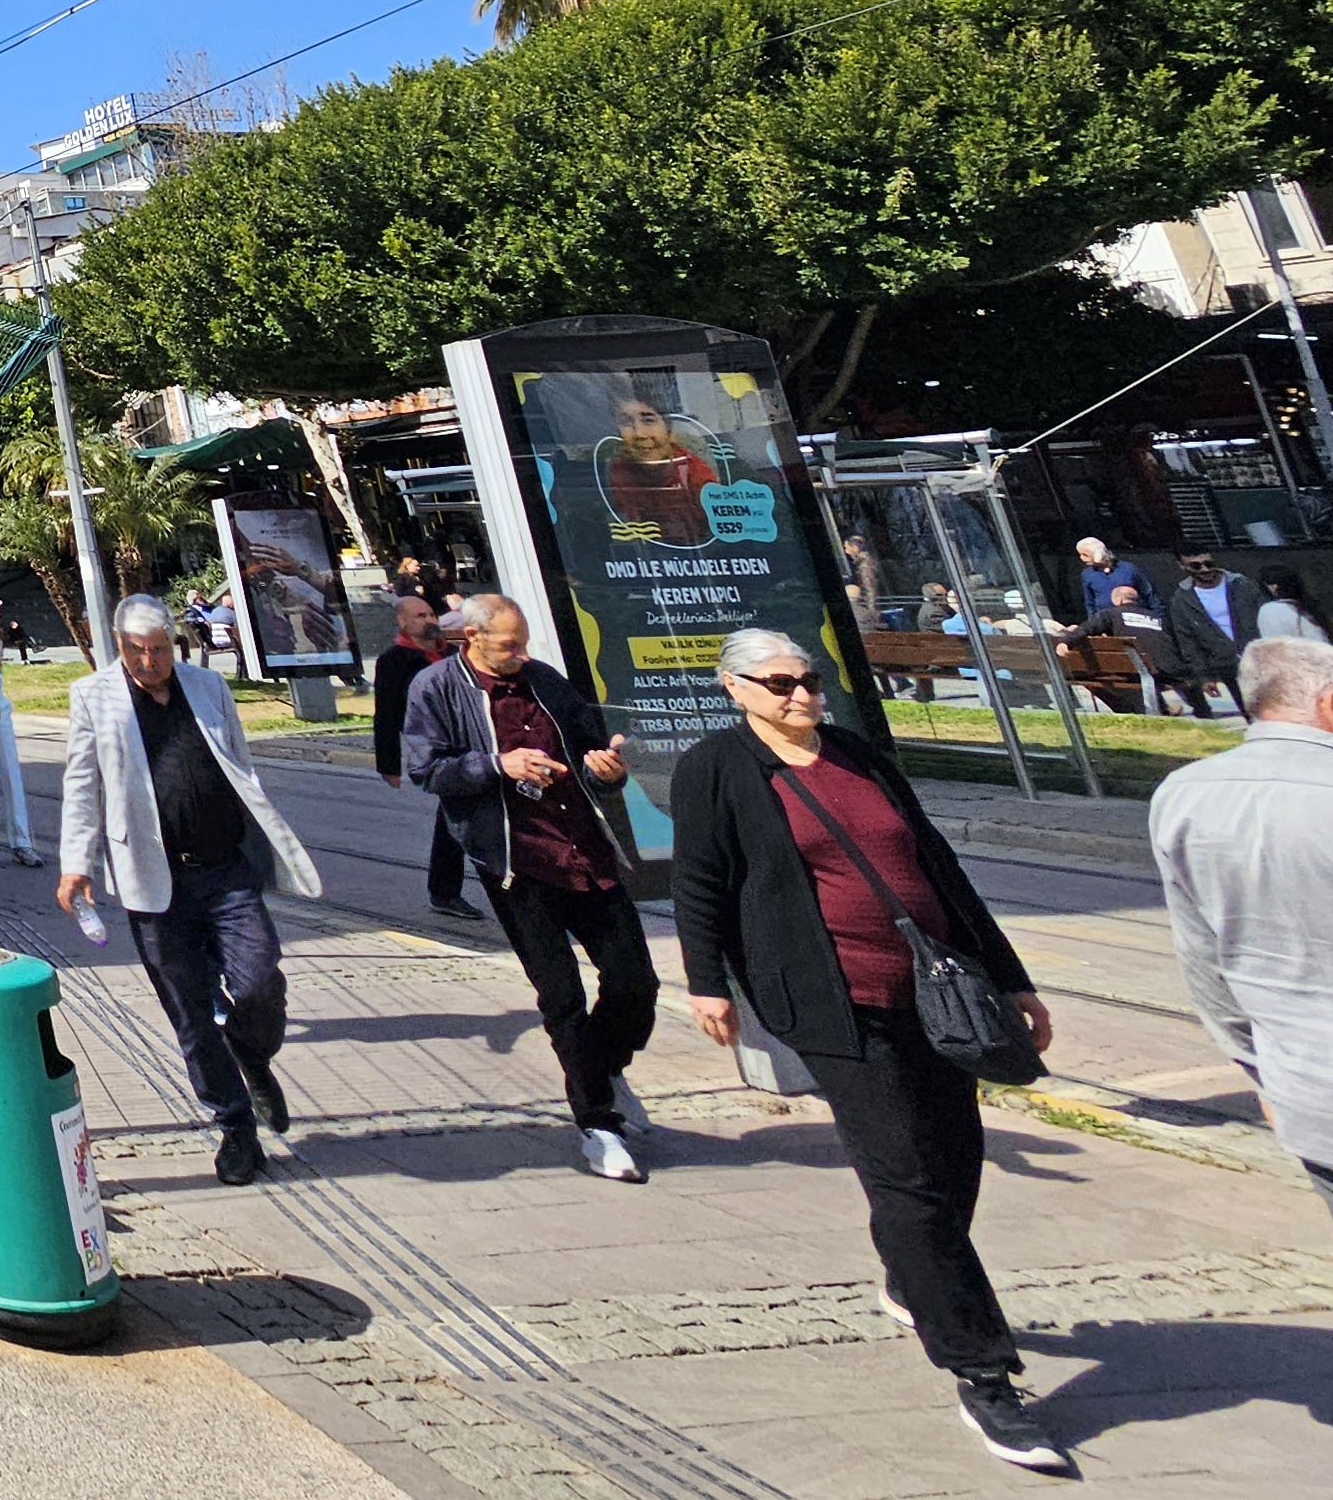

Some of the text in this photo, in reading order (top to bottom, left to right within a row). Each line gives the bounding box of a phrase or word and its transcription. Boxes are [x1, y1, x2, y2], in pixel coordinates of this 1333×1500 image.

[84, 94, 131, 126] HOTEL
[63, 117, 109, 148] GOLDEN
[107, 108, 135, 132] LUX
[712, 505, 751, 517] KEREM
[716, 521, 743, 534] 5529
[605, 556, 771, 579] DMD İLE MÜCADELE EDEN
[651, 586, 741, 605] KEREM YAPICI
[668, 696, 698, 711] 0001
